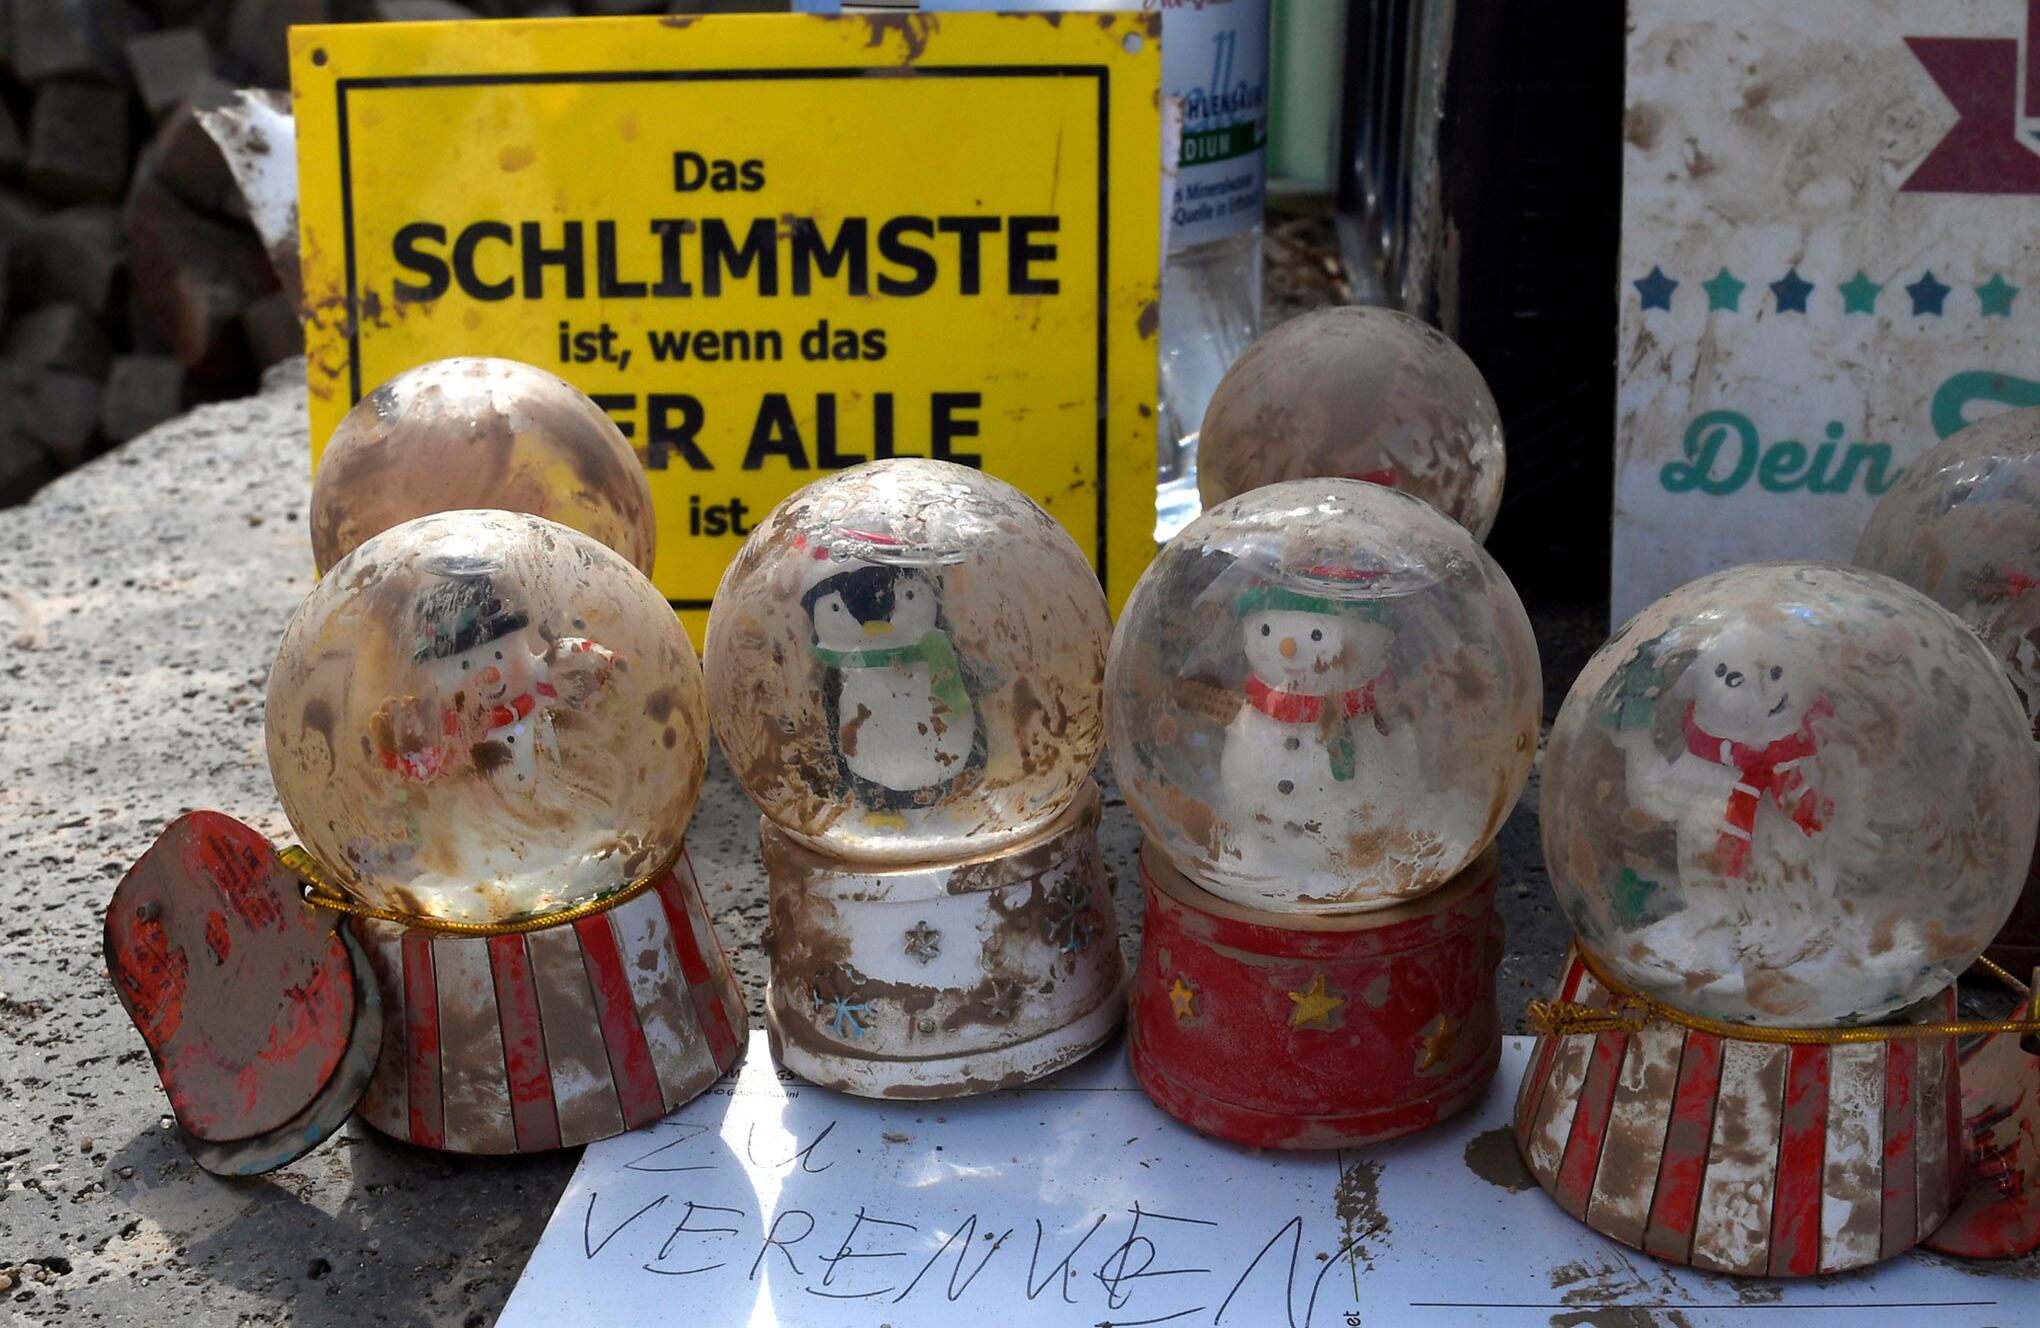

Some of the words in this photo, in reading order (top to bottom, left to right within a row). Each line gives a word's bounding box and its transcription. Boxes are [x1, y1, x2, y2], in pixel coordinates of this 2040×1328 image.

[672, 152, 766, 192] Das
[391, 215, 1062, 301] SCHLIMMSTE
[558, 323, 632, 371] ist,
[649, 330, 784, 364] wenn
[800, 321, 888, 361] das
[742, 392, 984, 470] ALLE
[1659, 409, 1905, 497] Dein
